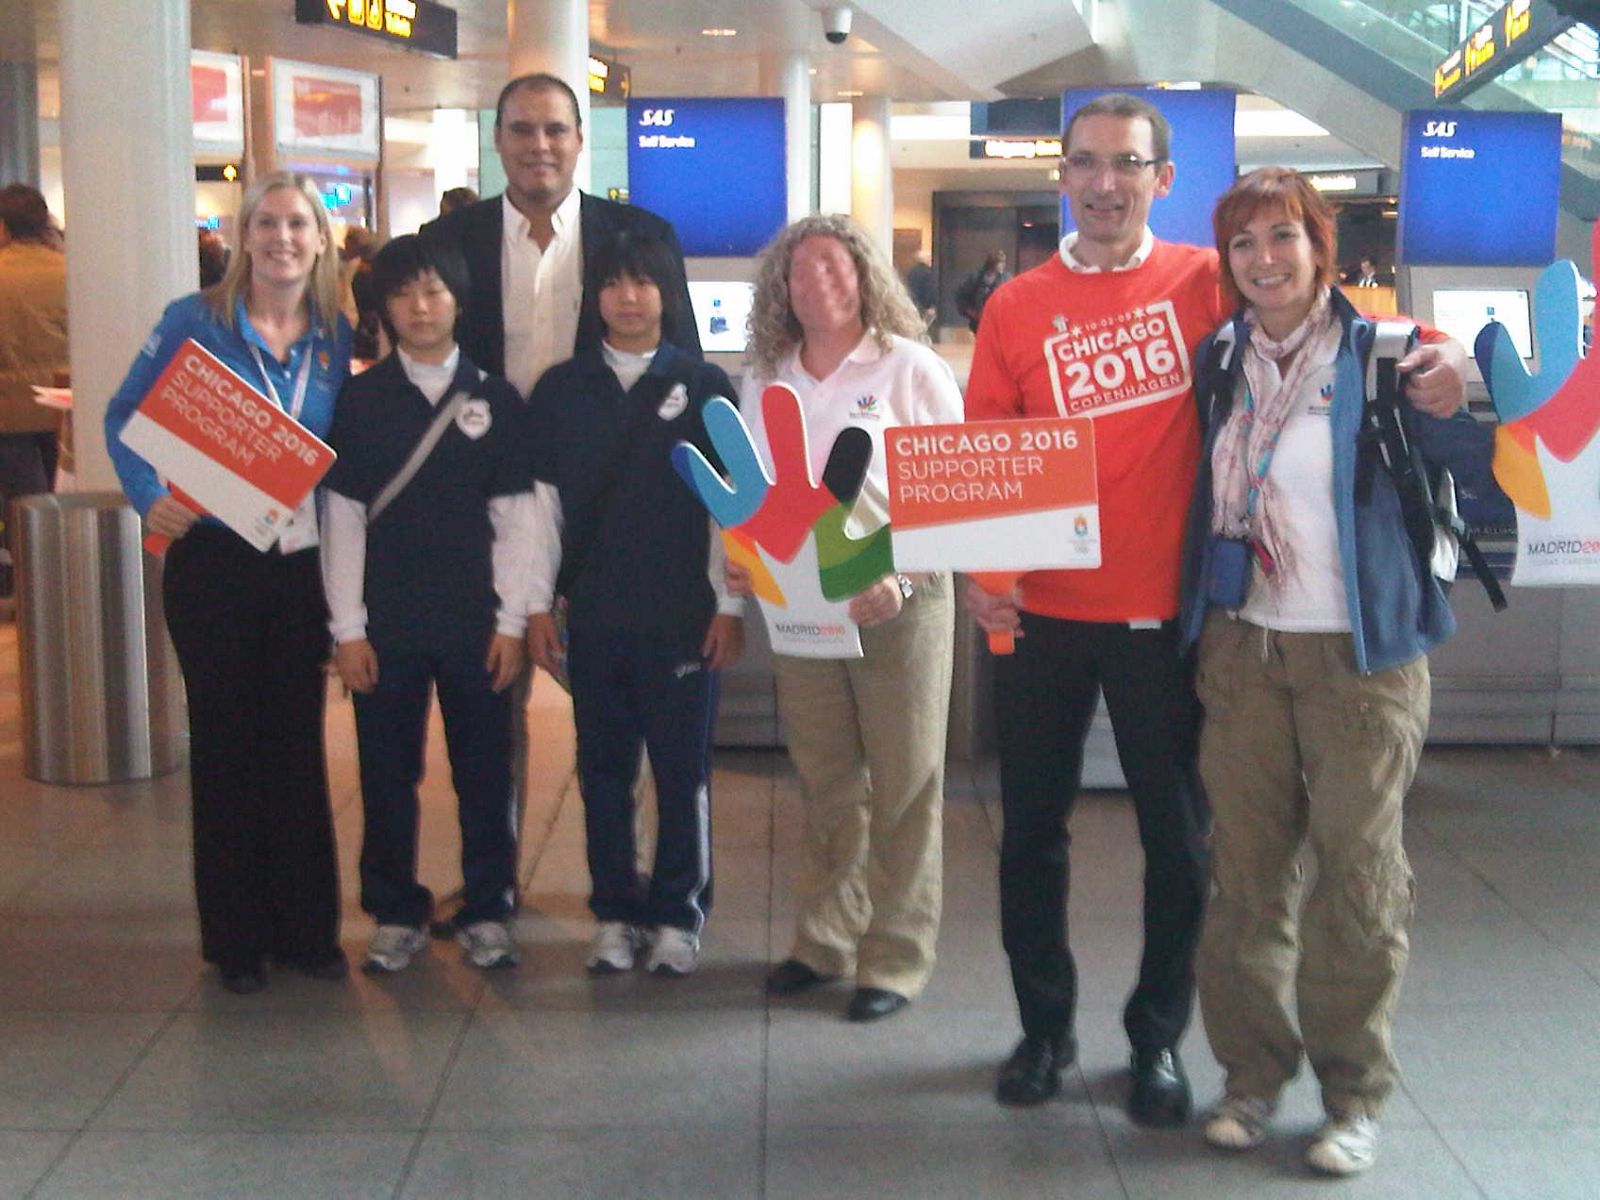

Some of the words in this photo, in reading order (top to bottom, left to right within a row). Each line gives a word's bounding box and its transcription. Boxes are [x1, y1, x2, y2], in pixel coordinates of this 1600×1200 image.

[638, 109, 675, 126] SAS
[1422, 121, 1458, 137] SAS
[1057, 318, 1165, 362] CHICAGO
[1065, 338, 1176, 399] 2016
[184, 354, 271, 427] CHICAGO
[272, 425, 319, 466] 2016
[1070, 373, 1180, 412] COPENHAGEN
[160, 384, 255, 466] PROGRAM
[172, 373, 282, 463] SUPPORTER
[896, 432, 1012, 456] CHICAGO
[1020, 430, 1079, 451] 2016
[898, 456, 1044, 481] SUPPORTER
[900, 480, 1023, 504] PROGRAM
